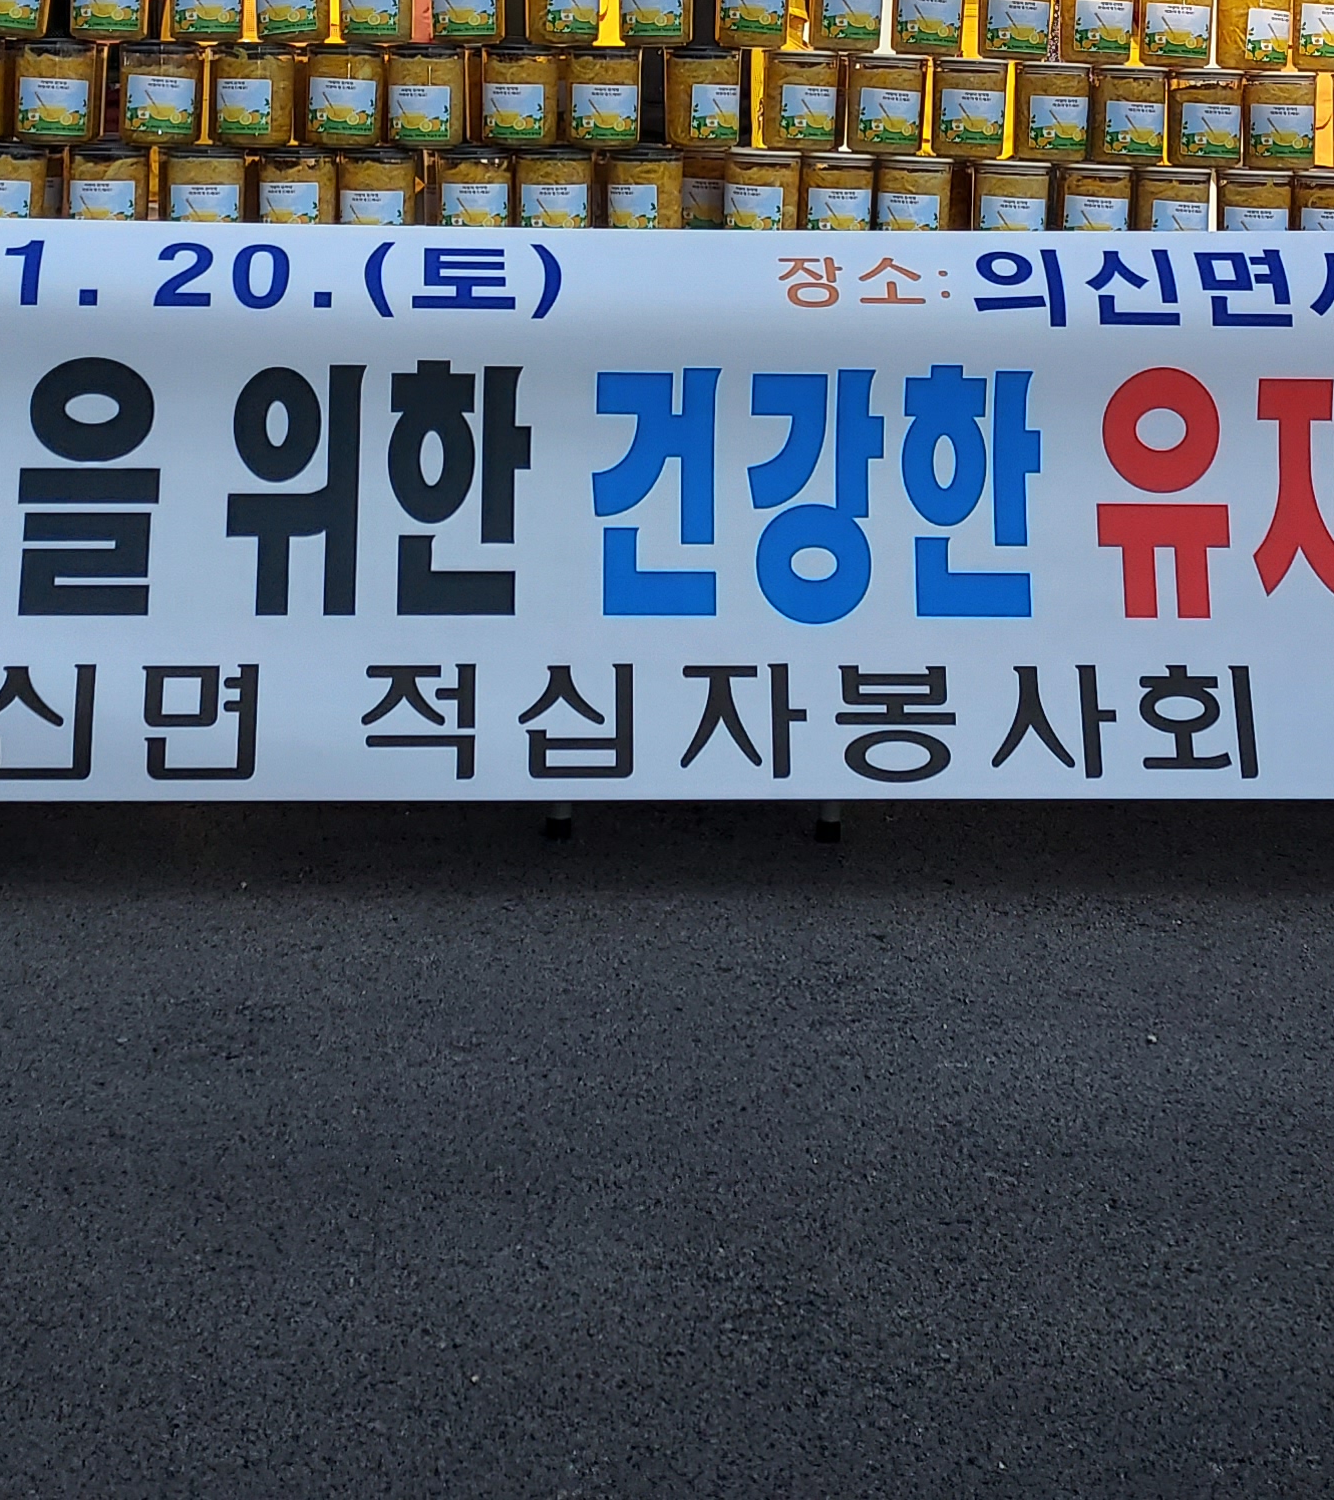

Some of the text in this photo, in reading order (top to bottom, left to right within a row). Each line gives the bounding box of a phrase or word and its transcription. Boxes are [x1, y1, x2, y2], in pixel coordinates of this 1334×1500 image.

[225, 358, 533, 617] 위한
[591, 363, 1042, 626] 건강한
[360, 660, 1262, 781] 적십자봉사회
